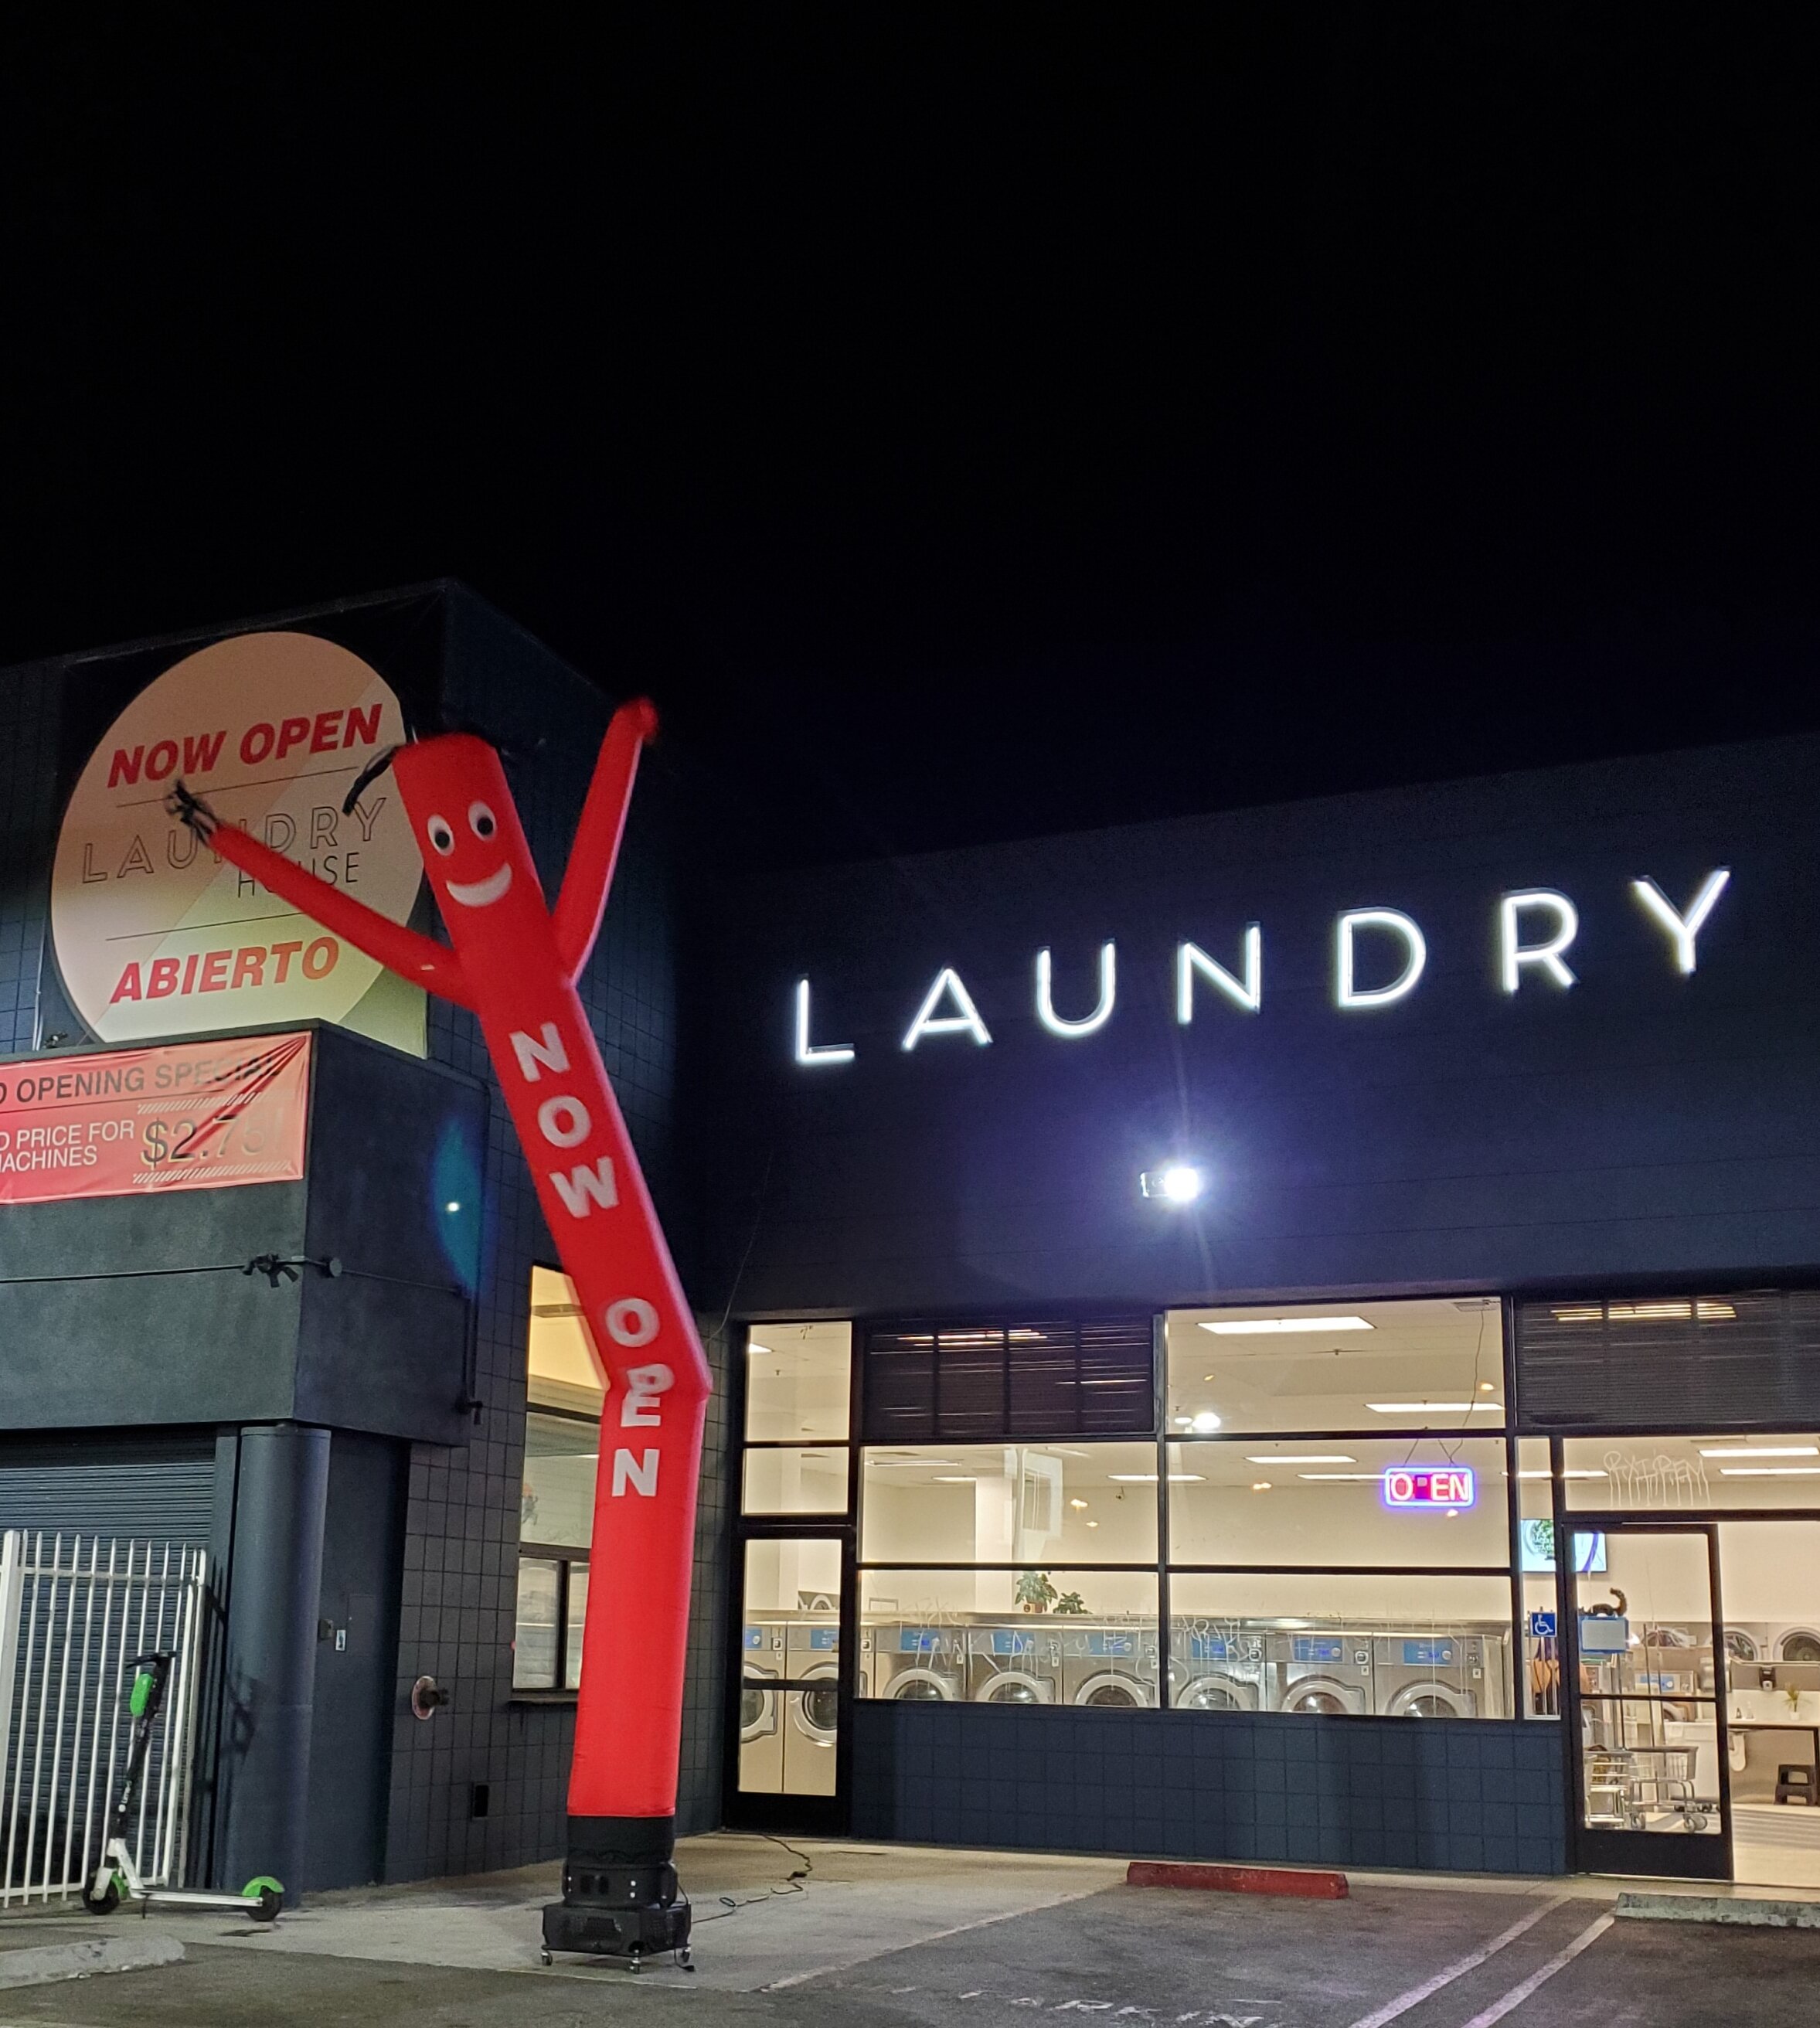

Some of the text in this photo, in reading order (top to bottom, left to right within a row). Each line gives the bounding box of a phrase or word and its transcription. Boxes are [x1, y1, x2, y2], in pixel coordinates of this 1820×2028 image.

[107, 704, 383, 788] NOW OPEN
[238, 852, 359, 898] HSE
[109, 936, 339, 1004] ABIERTO
[794, 866, 1731, 1065] LAUNDRY
[16, 1067, 145, 1103] OPENING
[16, 1124, 83, 1150] PRICE
[89, 1119, 134, 1142] FOR
[510, 1022, 675, 1497] NOW OPEN
